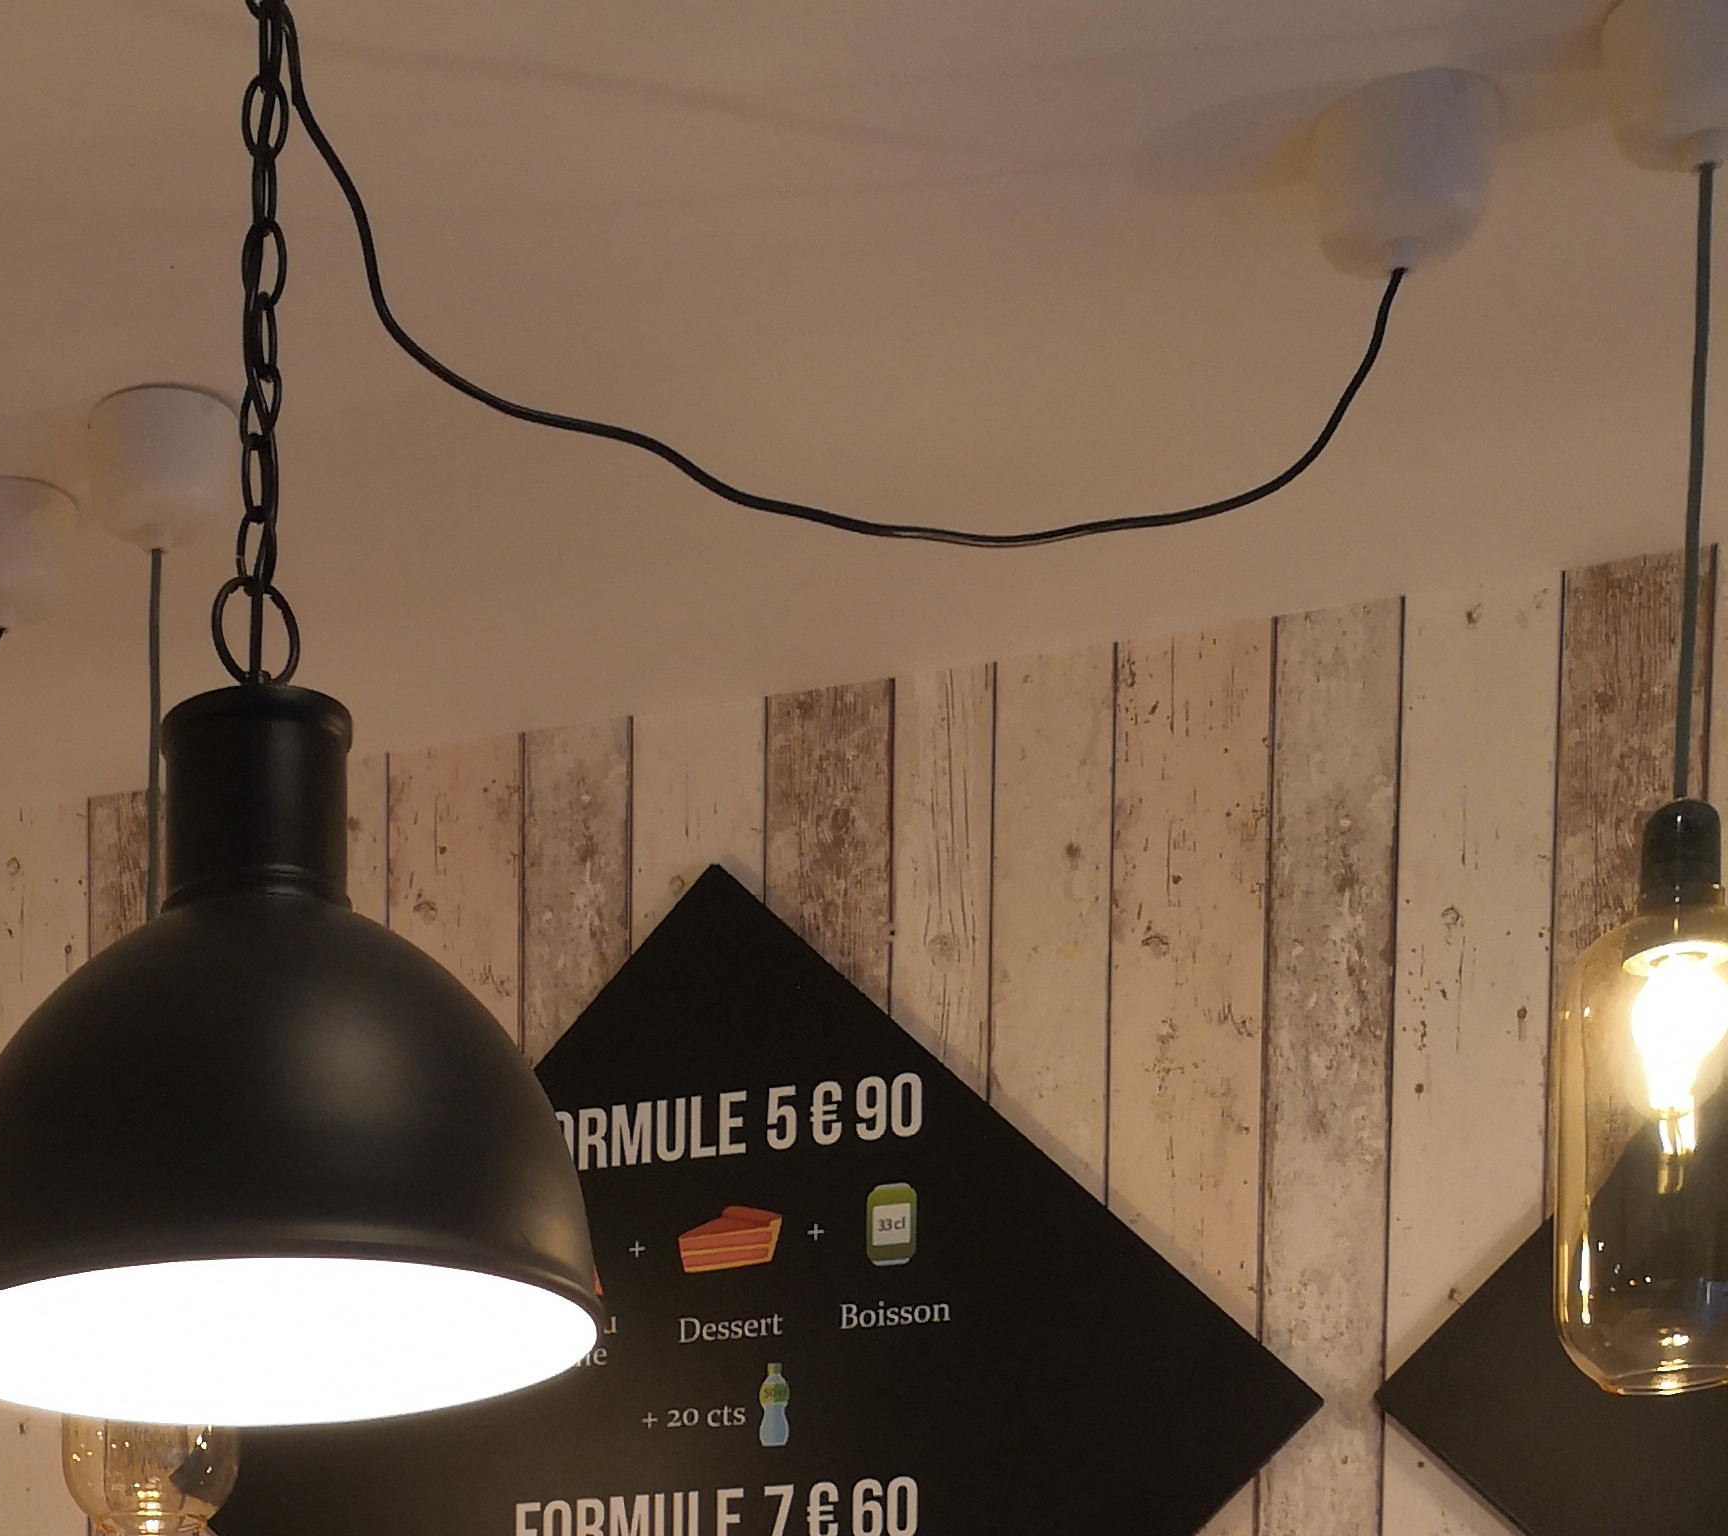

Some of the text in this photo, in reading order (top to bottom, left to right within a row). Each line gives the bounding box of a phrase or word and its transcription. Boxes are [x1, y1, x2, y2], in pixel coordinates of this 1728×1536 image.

[555, 1090, 747, 1171] RMULE
[678, 1312, 783, 1344] Dessert
[839, 1300, 952, 1331] Boisson
[666, 1407, 700, 1429] 20
[706, 1404, 746, 1428] cts
